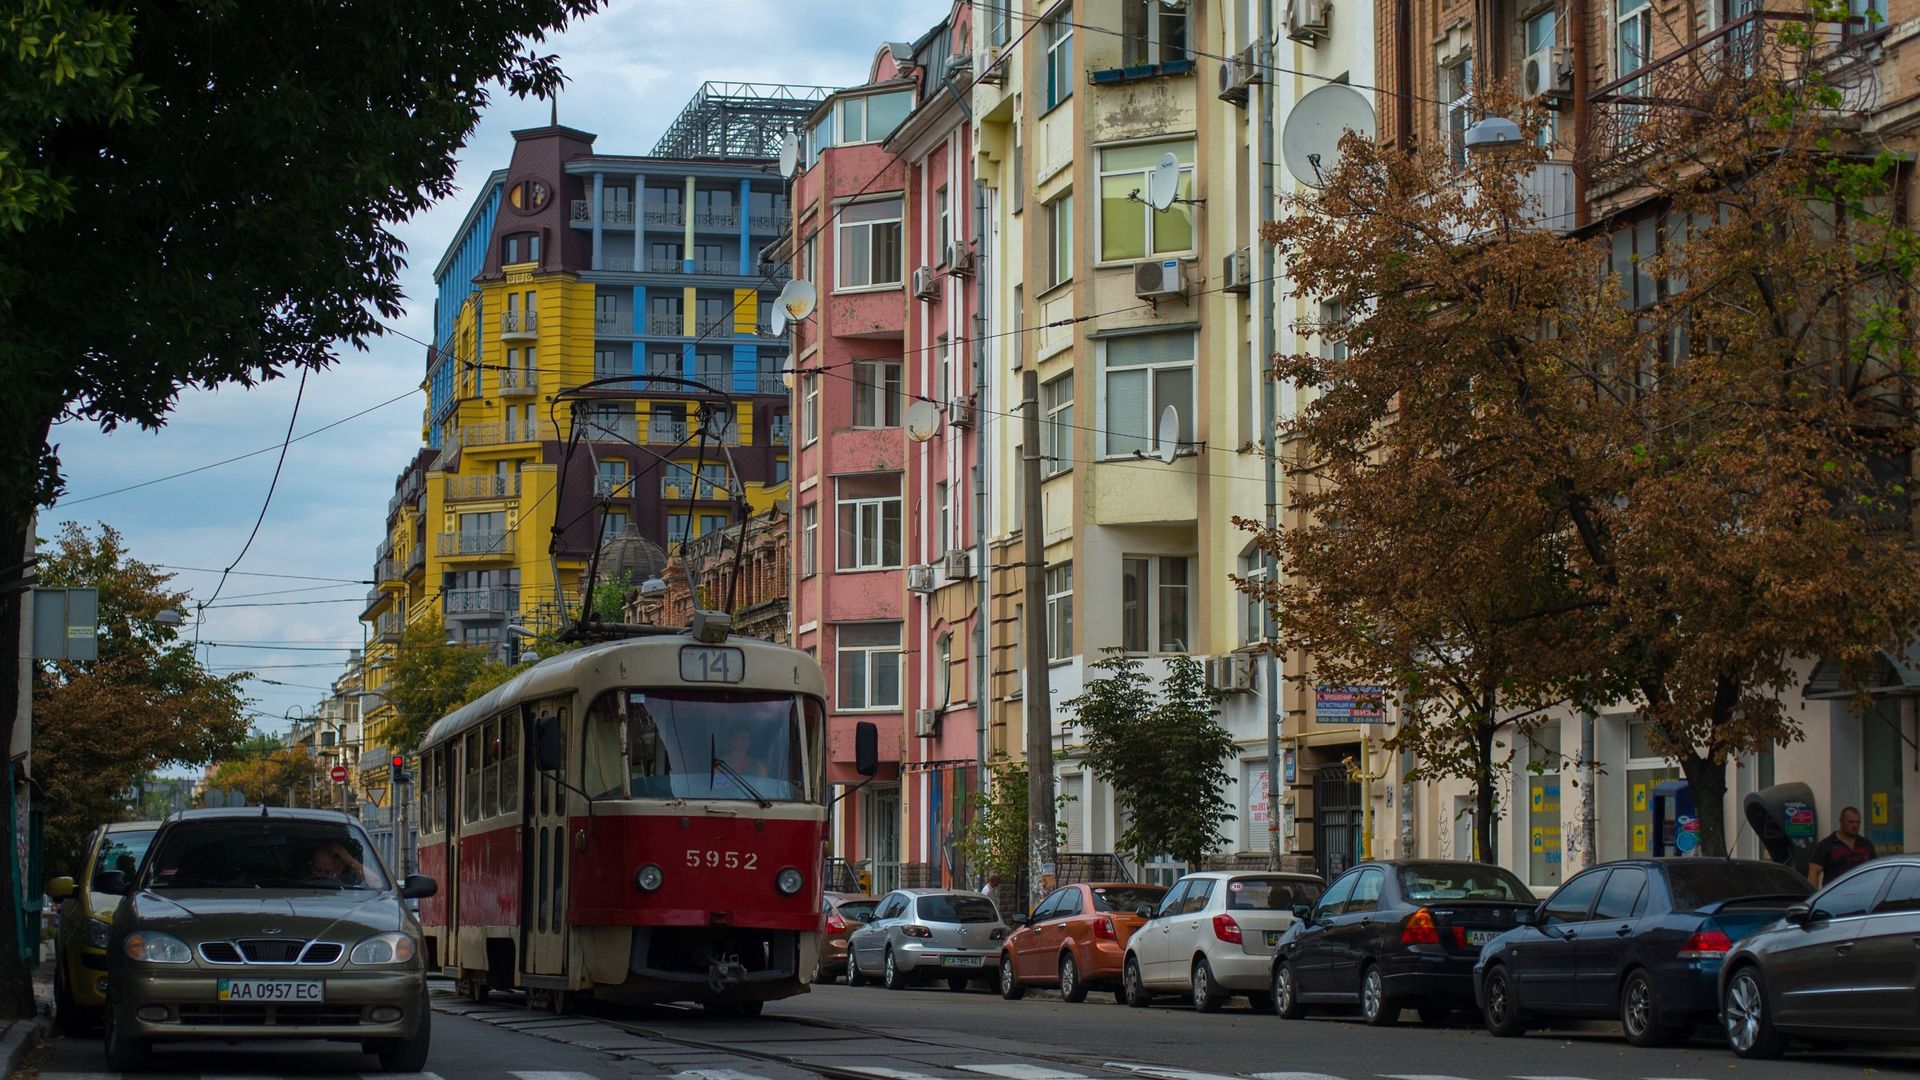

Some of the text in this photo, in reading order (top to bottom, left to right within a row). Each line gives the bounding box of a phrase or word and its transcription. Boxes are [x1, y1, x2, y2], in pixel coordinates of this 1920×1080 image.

[698, 651, 730, 681] 14
[686, 850, 758, 870] 5952
[230, 983, 318, 999] AA 0957 EC
